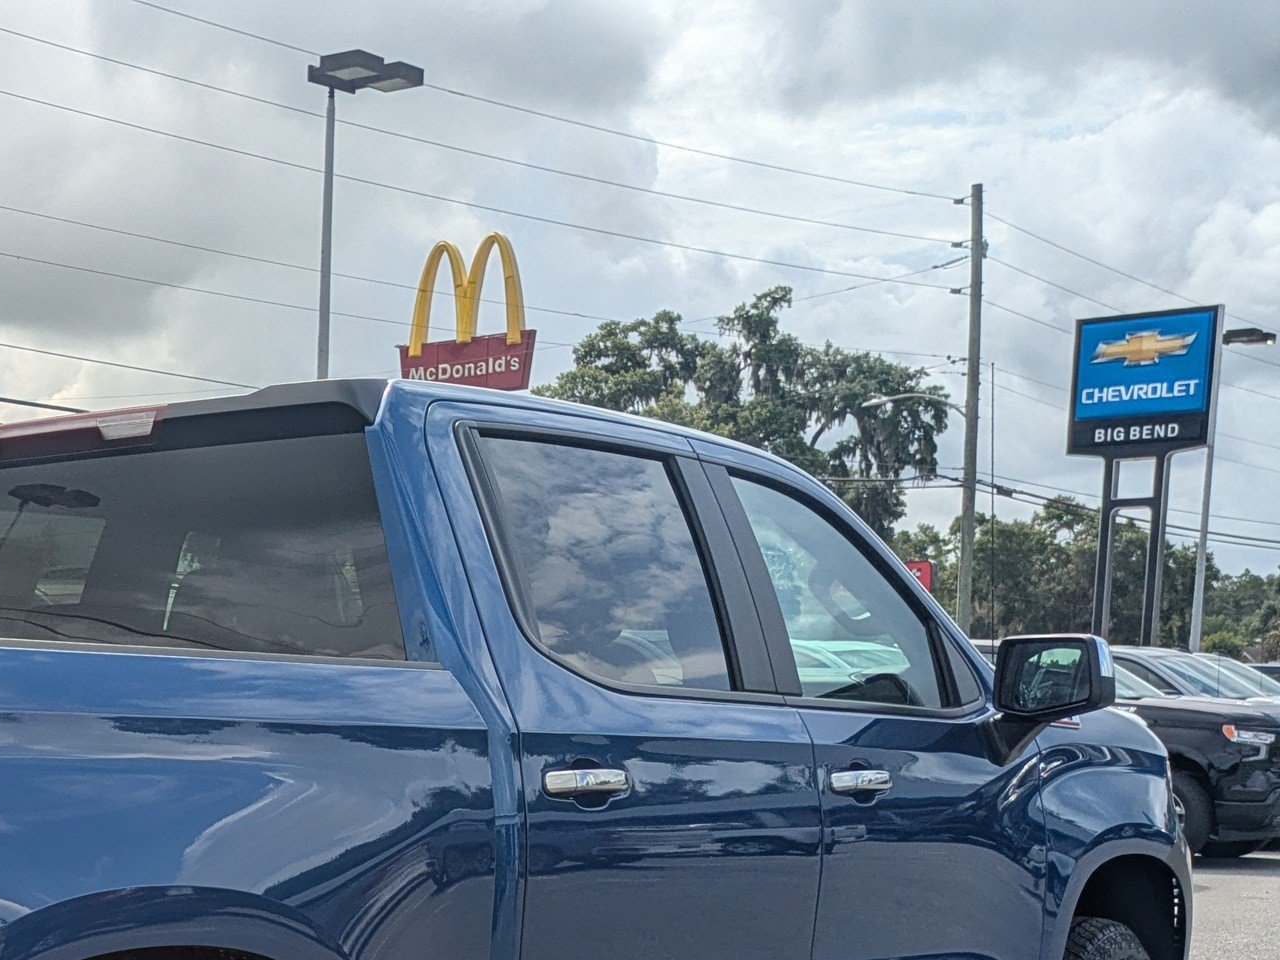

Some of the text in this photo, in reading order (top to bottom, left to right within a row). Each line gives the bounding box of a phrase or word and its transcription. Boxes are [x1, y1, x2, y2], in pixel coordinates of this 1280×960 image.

[409, 356, 519, 380] McDonald's
[1081, 379, 1200, 404] CHEVROLET
[1094, 423, 1179, 443] BIG BEND
